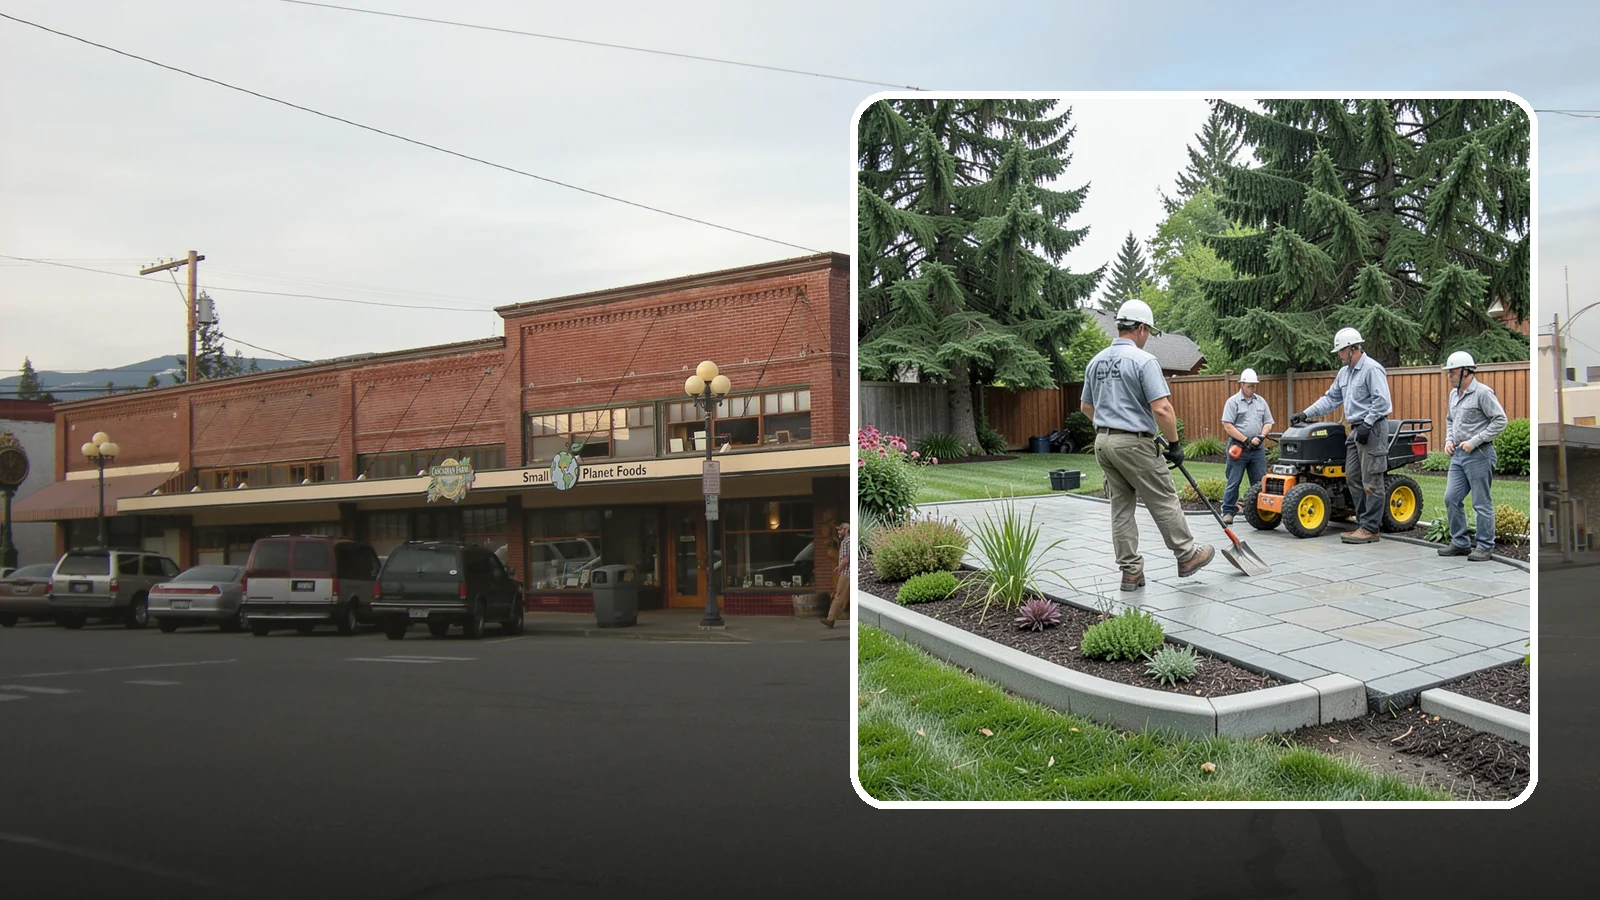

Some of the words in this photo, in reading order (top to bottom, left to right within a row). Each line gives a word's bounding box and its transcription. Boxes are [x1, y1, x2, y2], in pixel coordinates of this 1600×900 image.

[431, 466, 456, 476] CASCADIAN
[522, 471, 549, 483] Small
[582, 467, 614, 479] Planet
[616, 464, 647, 477] Foods
